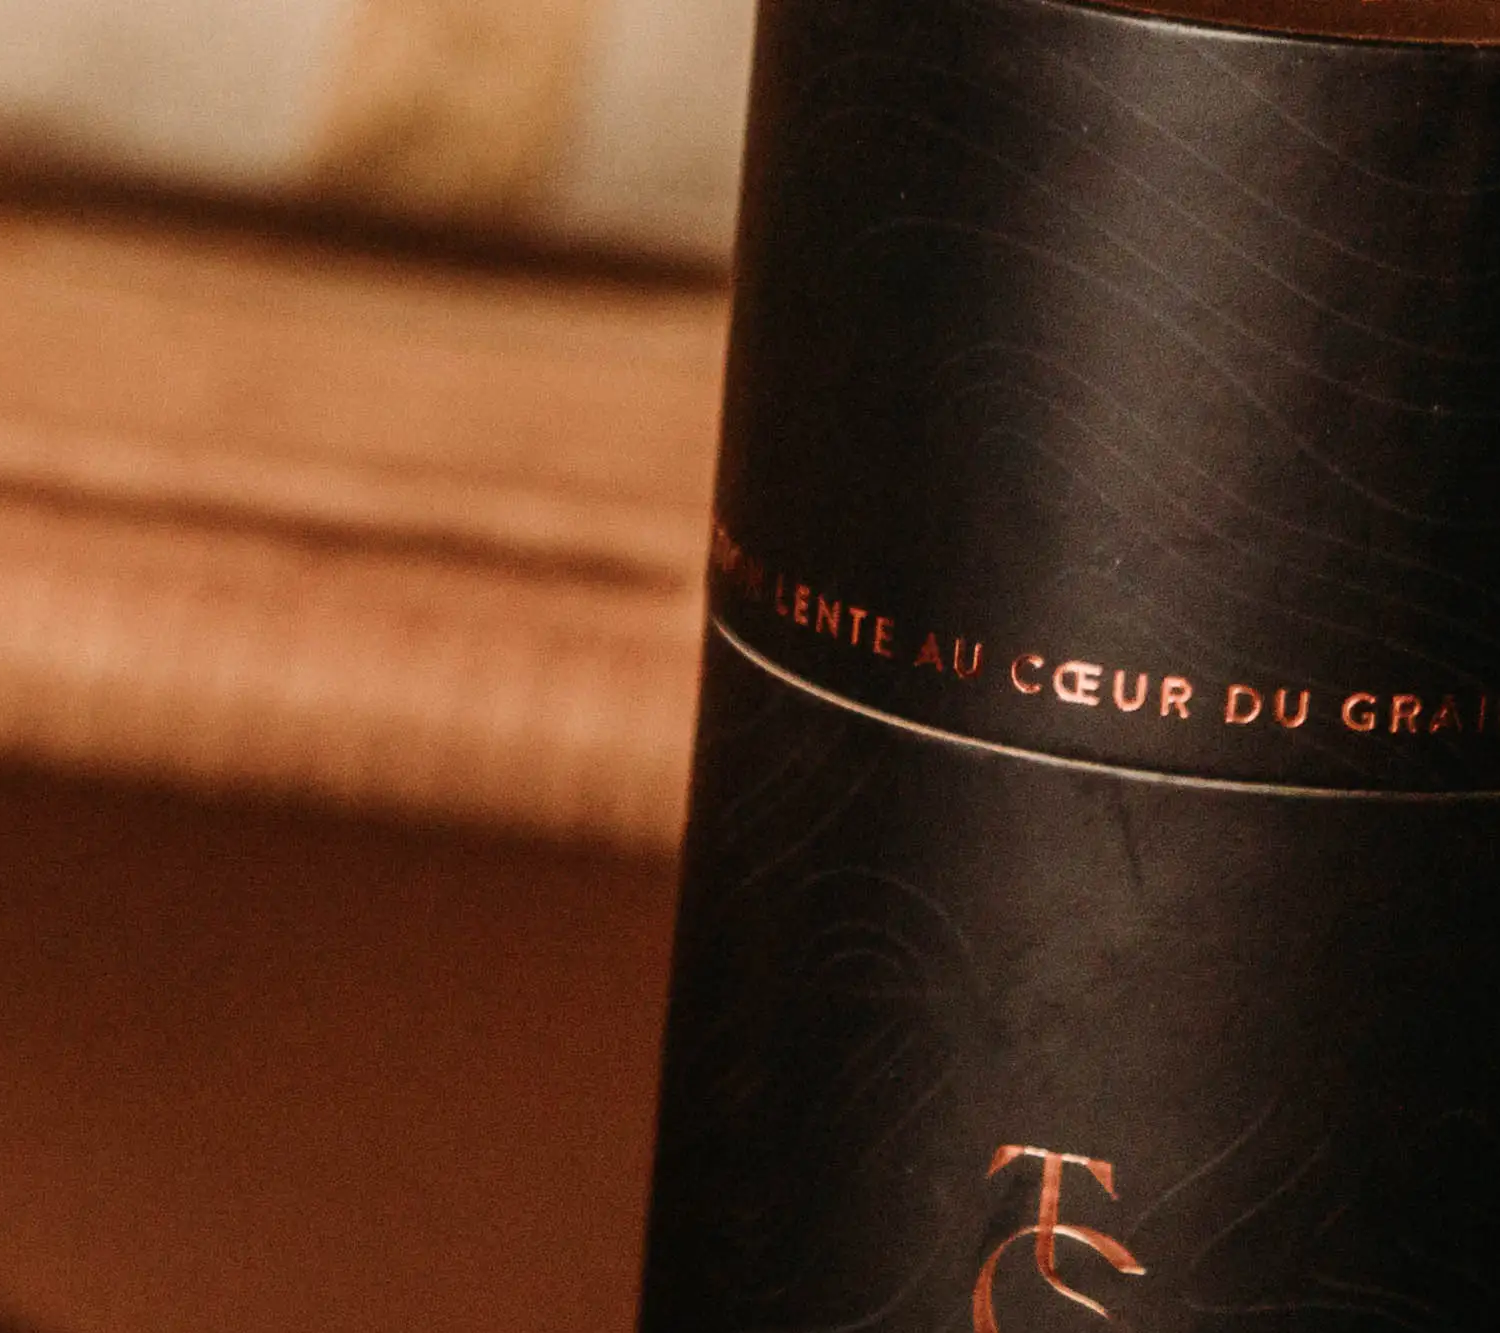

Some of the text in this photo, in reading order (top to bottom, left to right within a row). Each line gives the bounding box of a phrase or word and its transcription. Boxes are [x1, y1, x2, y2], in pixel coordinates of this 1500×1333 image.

[774, 573, 895, 660] LENTE
[912, 630, 983, 682] AU
[1009, 652, 1193, 721] CŒUR
[1222, 682, 1311, 730] DU
